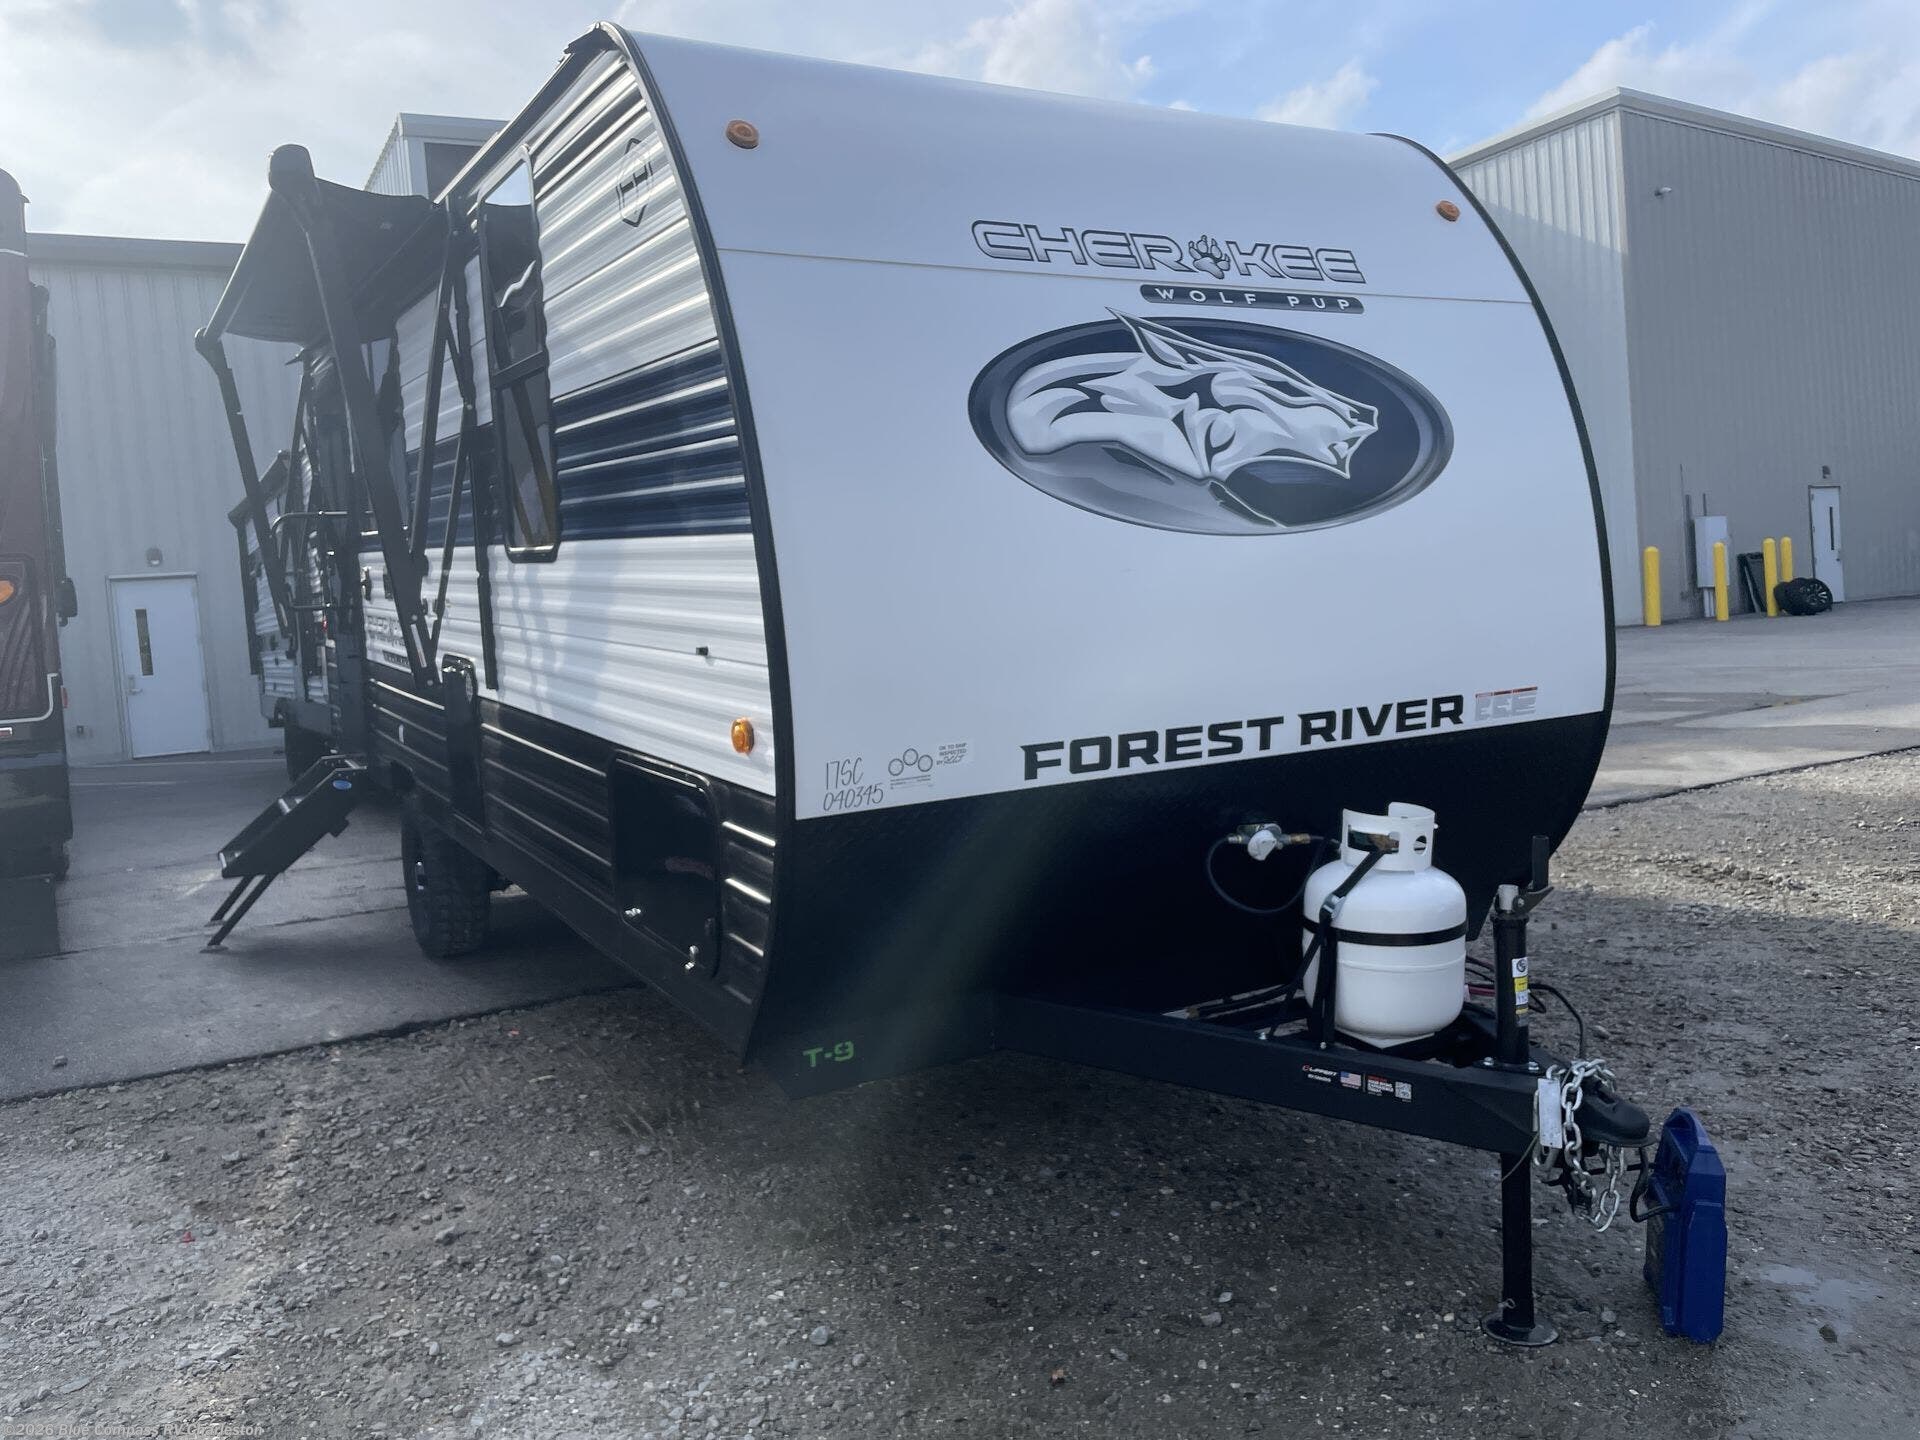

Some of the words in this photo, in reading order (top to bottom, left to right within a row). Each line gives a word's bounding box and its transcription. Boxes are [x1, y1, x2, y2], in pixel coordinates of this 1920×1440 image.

[971, 219, 1366, 284] CHEROKEE
[1154, 287, 1256, 305] WOLF
[1287, 295, 1350, 310] PUP
[1020, 715, 1284, 781] FOREST
[1297, 694, 1464, 747] RIVER
[823, 782, 884, 811] 040345
[802, 1040, 854, 1068] T-9
